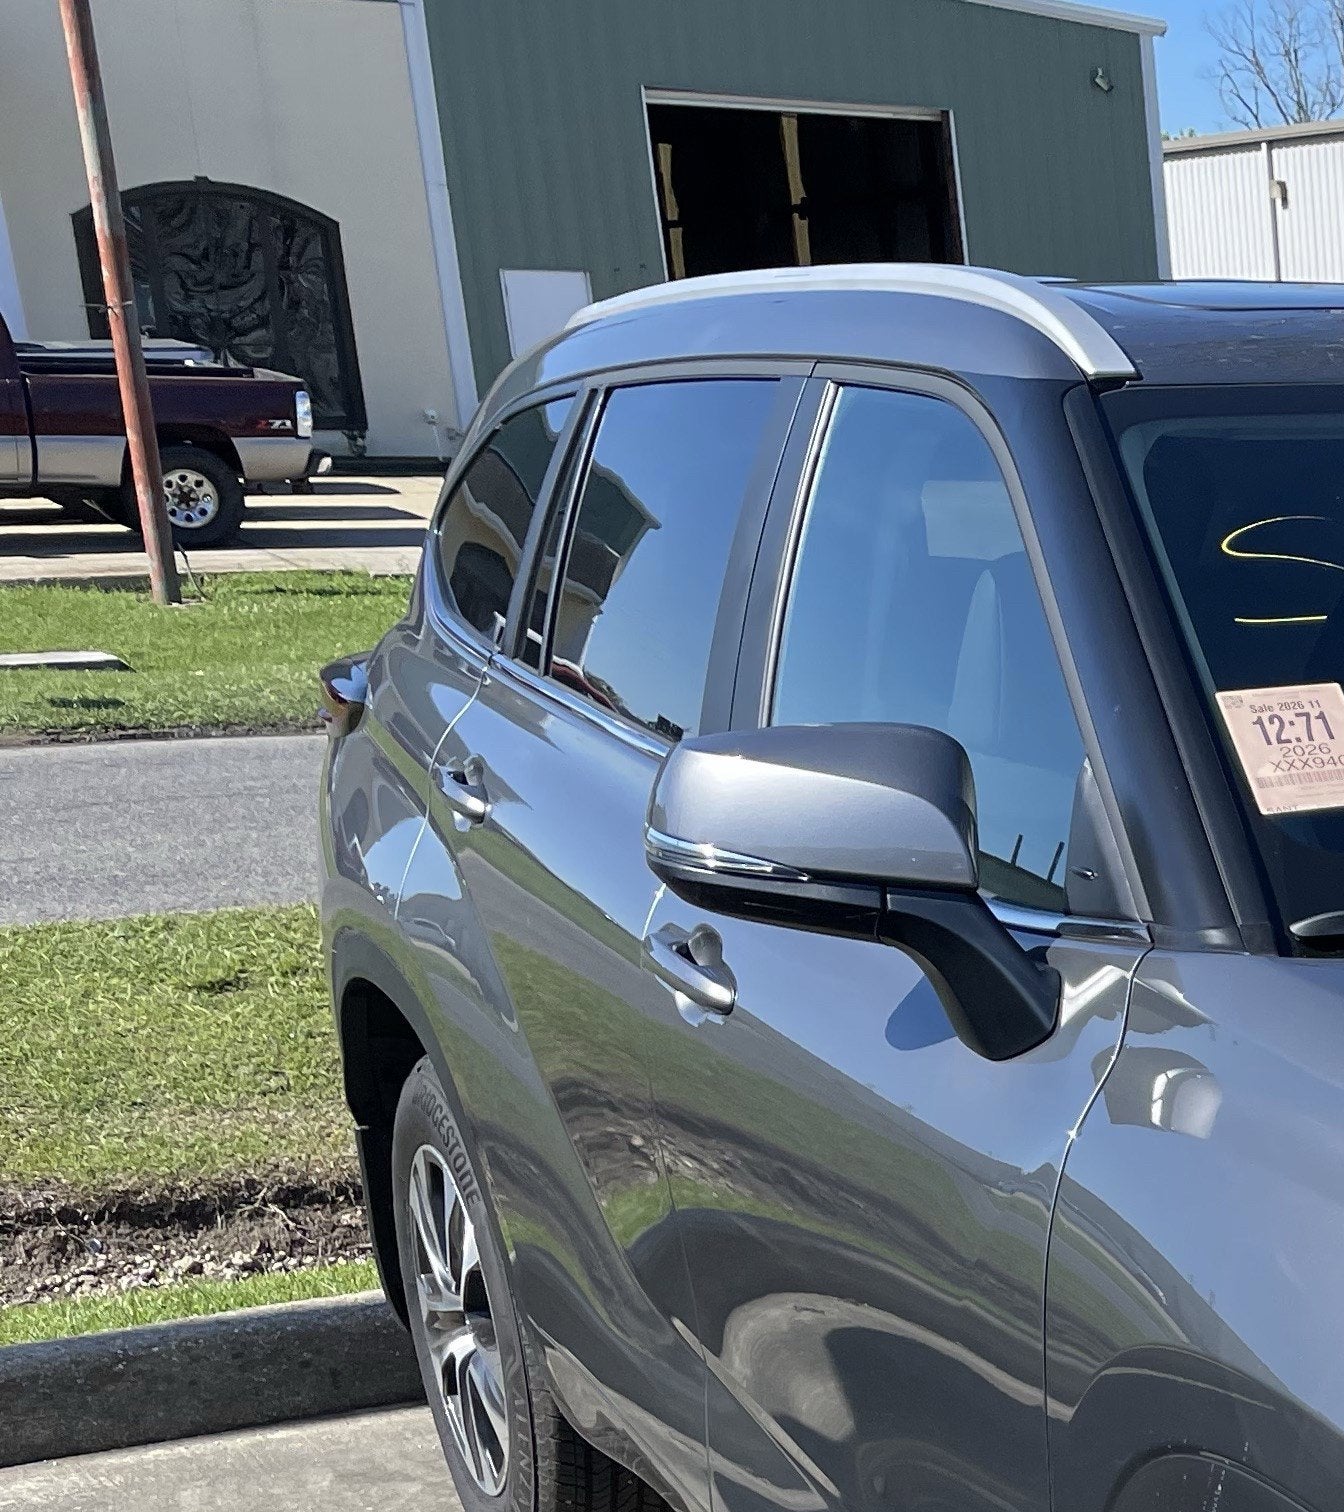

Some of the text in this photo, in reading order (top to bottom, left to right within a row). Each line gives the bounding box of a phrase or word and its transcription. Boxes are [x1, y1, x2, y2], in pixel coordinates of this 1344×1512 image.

[1249, 704, 1274, 714] Sale
[1252, 710, 1335, 746] 12:71
[1280, 742, 1331, 758] 2026
